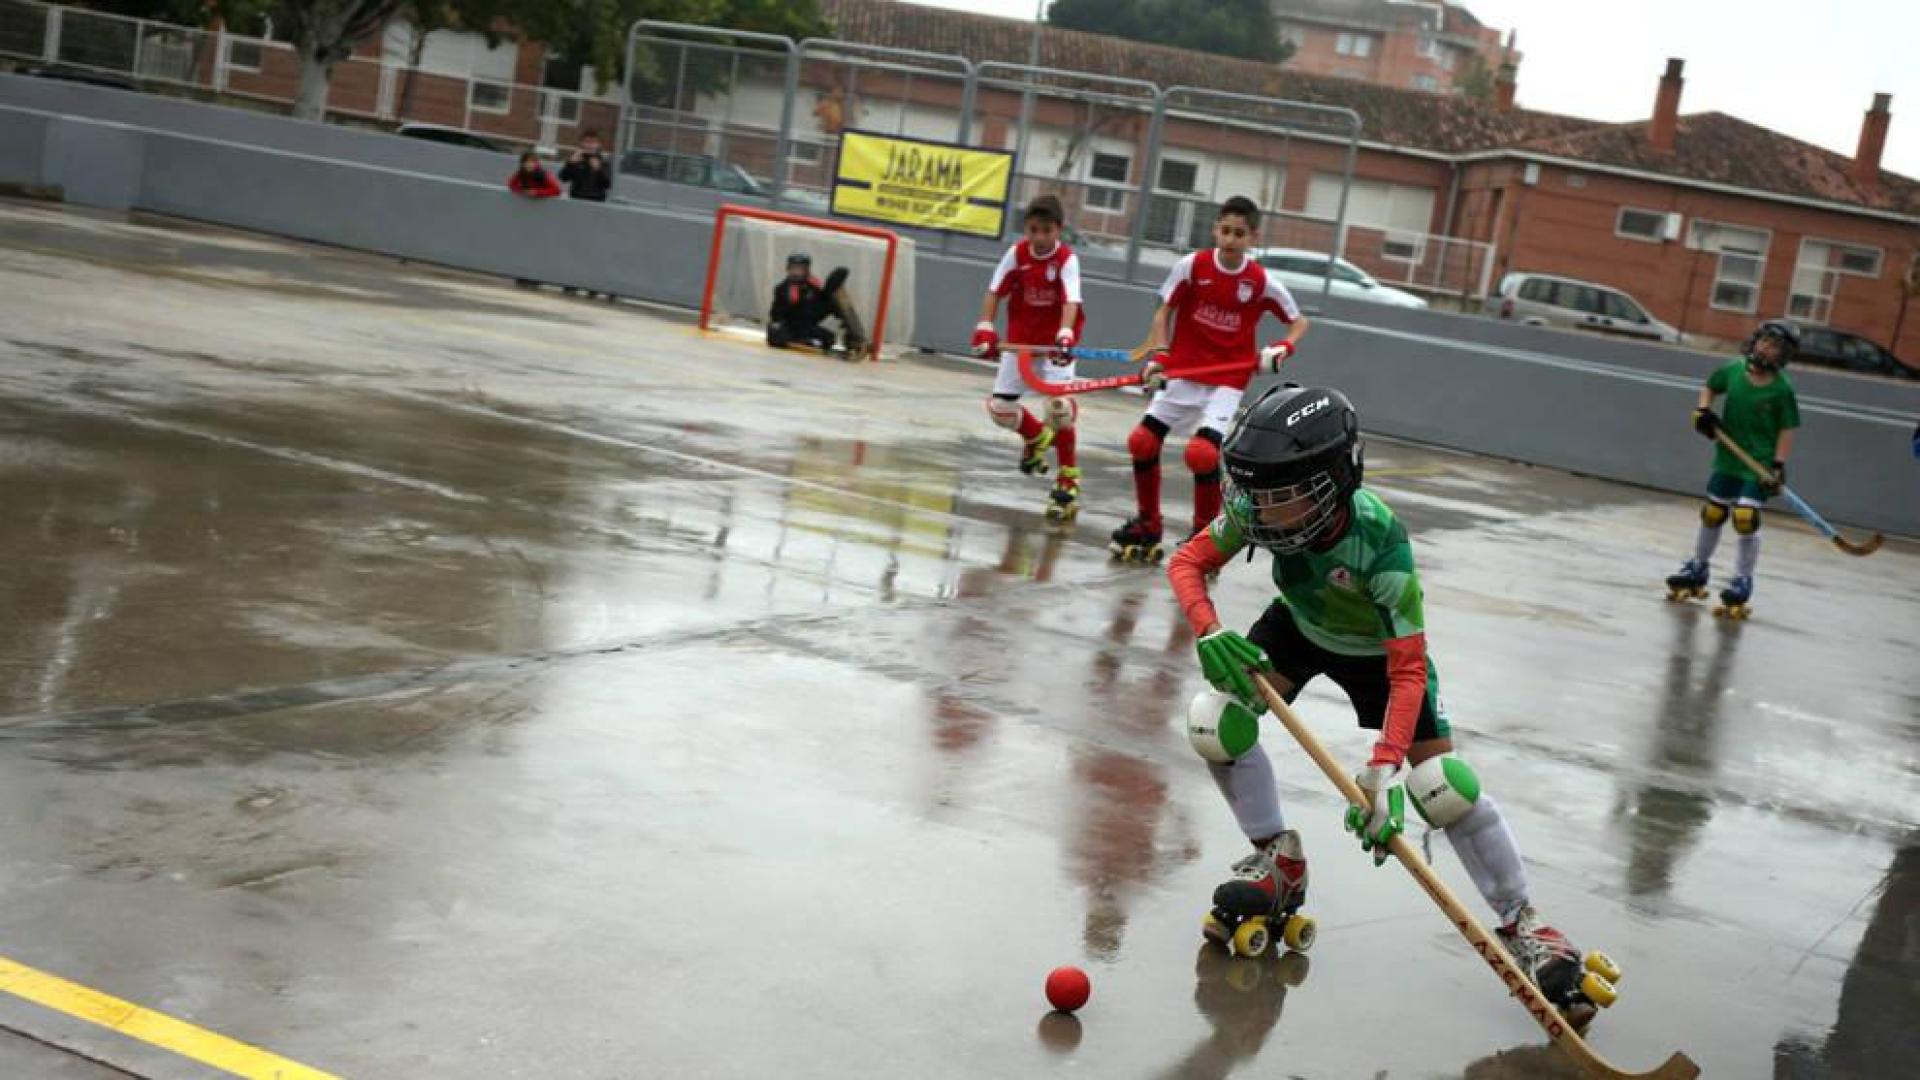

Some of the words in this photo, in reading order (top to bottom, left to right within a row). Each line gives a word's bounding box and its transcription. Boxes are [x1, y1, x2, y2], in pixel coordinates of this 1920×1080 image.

[882, 143, 962, 187] JARAMA
[1286, 396, 1330, 427] CCM
[1473, 940, 1563, 1038] AZEMAD
